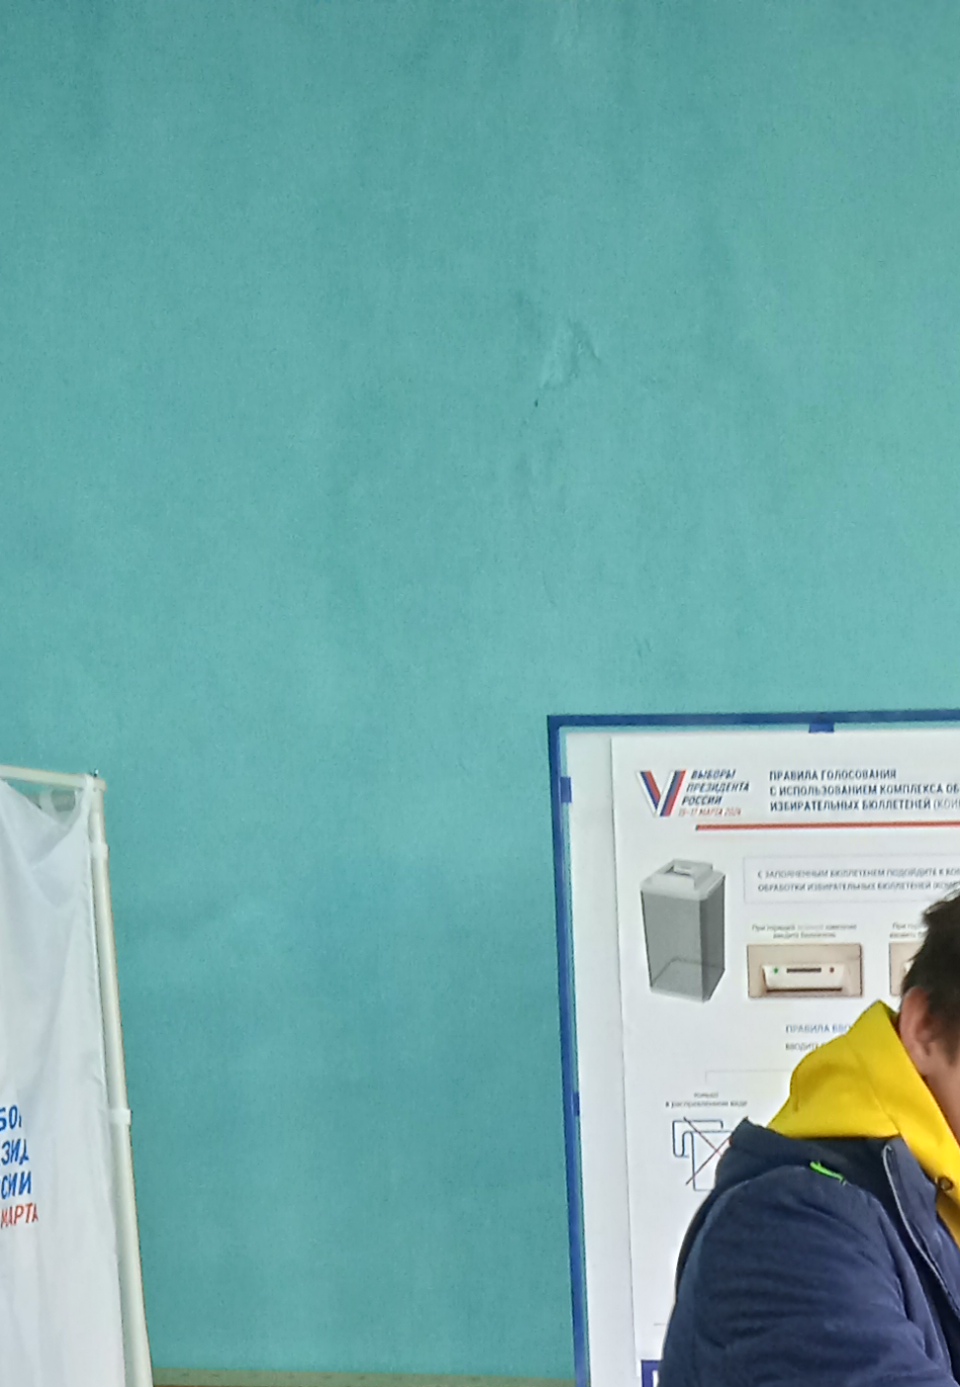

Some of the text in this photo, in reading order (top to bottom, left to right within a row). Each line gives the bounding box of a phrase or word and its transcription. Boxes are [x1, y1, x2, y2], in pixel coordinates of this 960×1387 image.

[691, 769, 737, 780] ВЫБОРЫ
[769, 768, 896, 781] ПРАВИЛА ГОЛОСОВАНИЯ
[686, 781, 750, 793] ПРЕЗИДЕНТА
[770, 785, 776, 796] С
[779, 784, 877, 796] ИСПОЛЬЗОВАНИЕМ
[880, 783, 943, 795] КОМПЛЕКСА
[681, 795, 723, 806] РОССИИ
[770, 799, 860, 812] ИЗБИРАТЕЛЬНЫХ
[862, 798, 931, 811] БЮЛЛЕТЕНЕЙ
